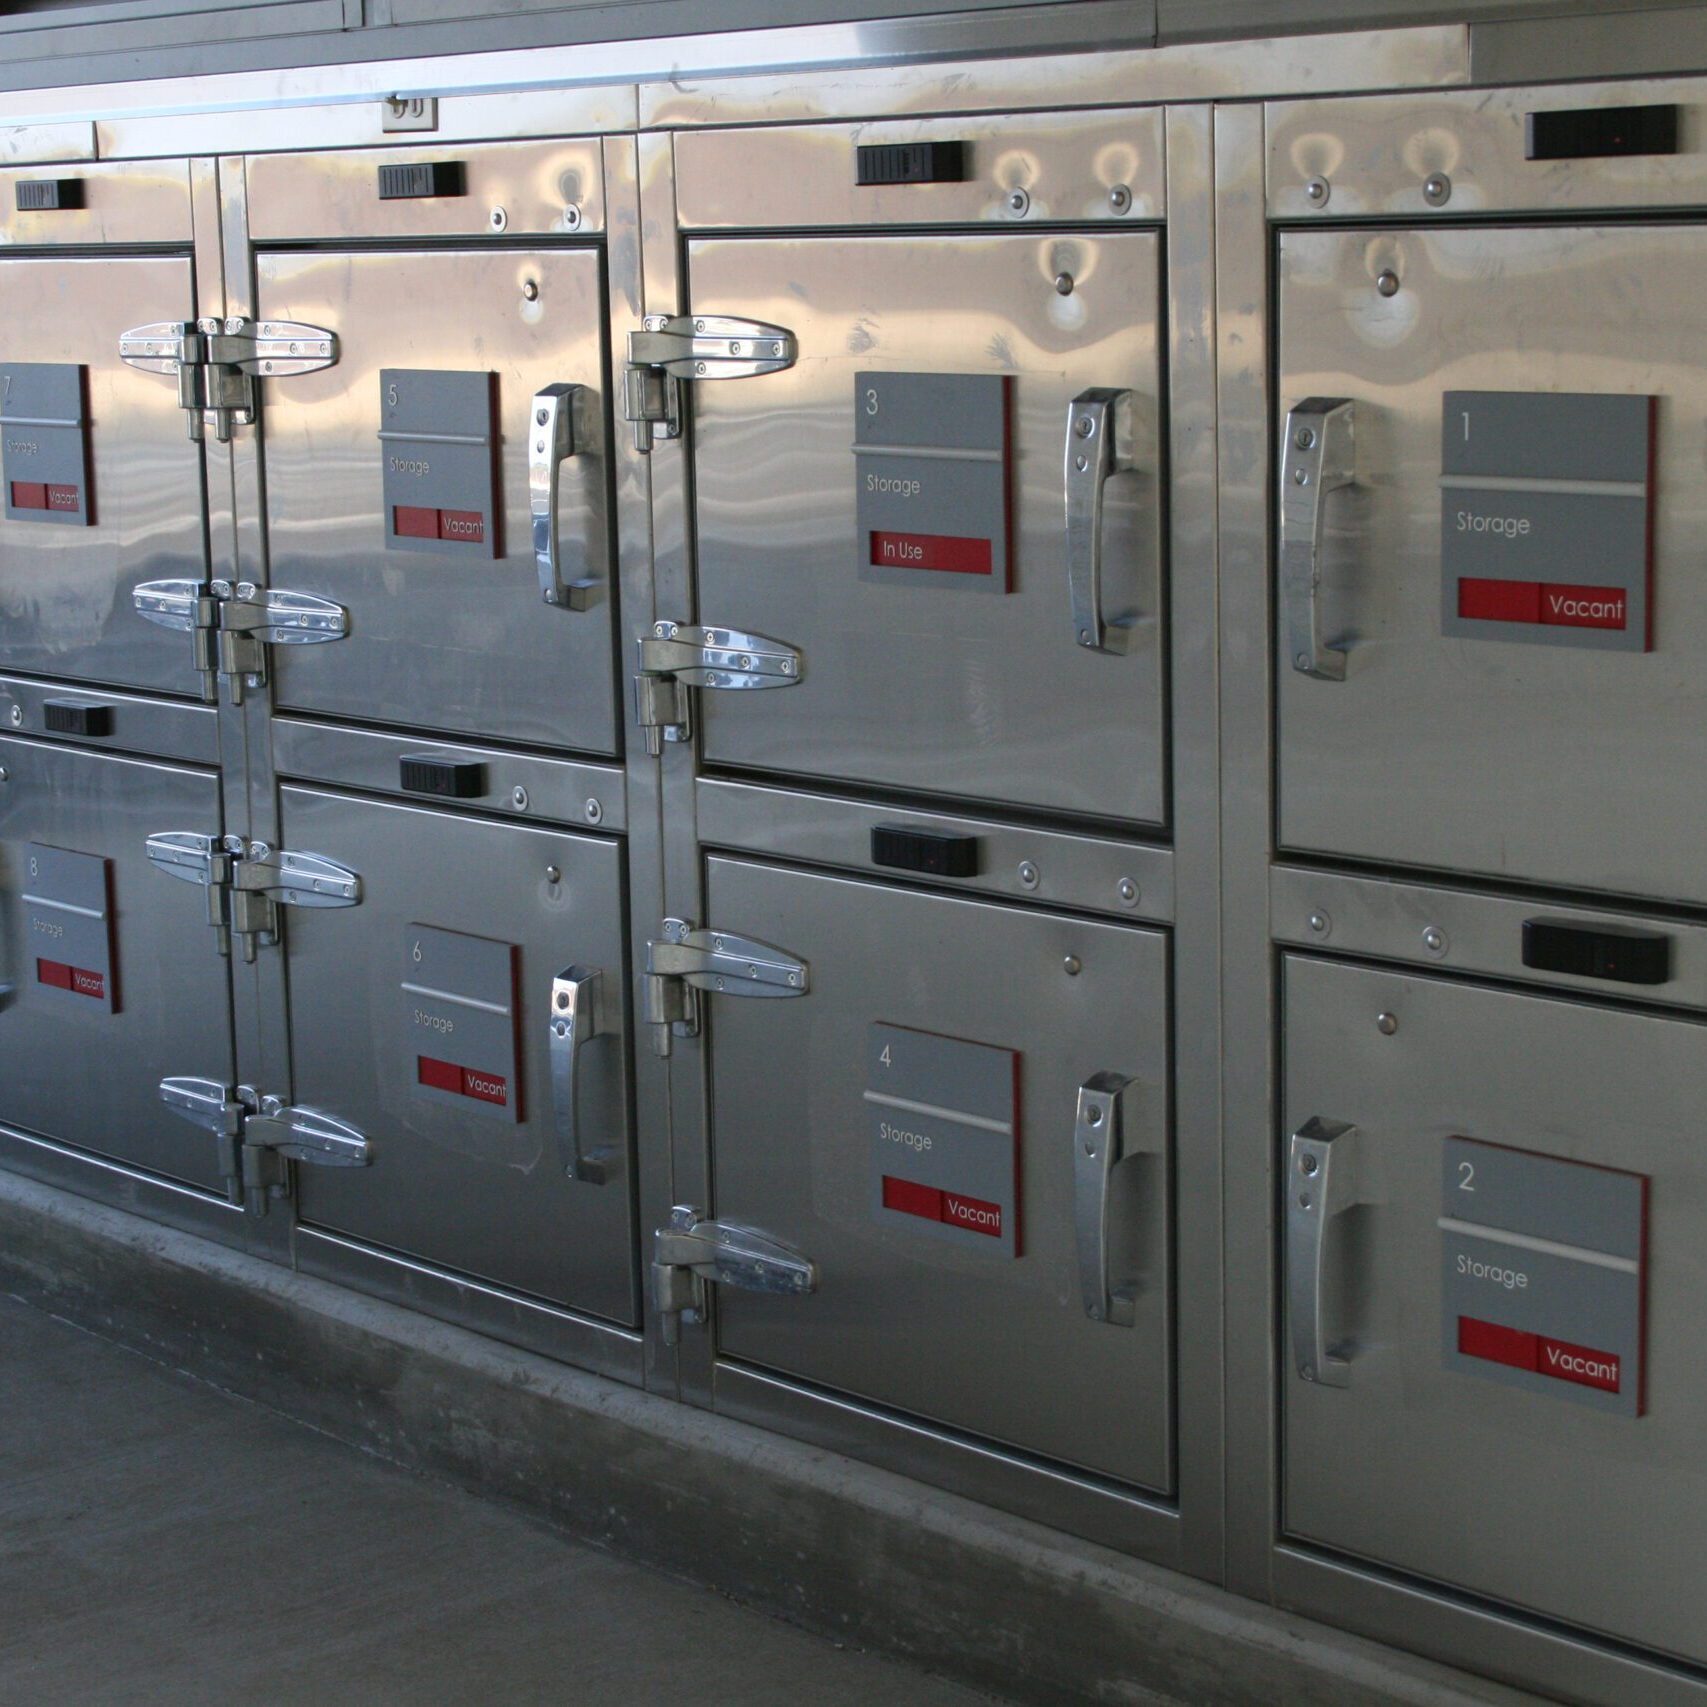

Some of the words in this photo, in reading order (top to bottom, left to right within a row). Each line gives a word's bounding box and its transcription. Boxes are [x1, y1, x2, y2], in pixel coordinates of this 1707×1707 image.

[388, 384, 398, 406] 5
[866, 389, 878, 415] 3
[1462, 412, 1470, 441] 1
[7, 440, 38, 456] Storage
[390, 457, 430, 476] Storage
[867, 474, 921, 497] Storage
[443, 518, 484, 534] Vacant
[1457, 511, 1531, 538] Storage
[883, 541, 895, 558] In
[899, 542, 923, 560] Use
[1549, 595, 1624, 619] Vacant
[30, 857, 38, 876] 8
[32, 918, 64, 938] Storage
[413, 941, 422, 962] 6
[414, 1009, 454, 1033] Storage
[880, 1044, 892, 1068] 4
[468, 1074, 507, 1098] Vacant
[880, 1122, 933, 1151] Storage
[1458, 1162, 1475, 1192] 2
[948, 1199, 1001, 1227] Vacant
[1457, 1254, 1528, 1289] Storage
[1546, 1346, 1619, 1381] Vacant
